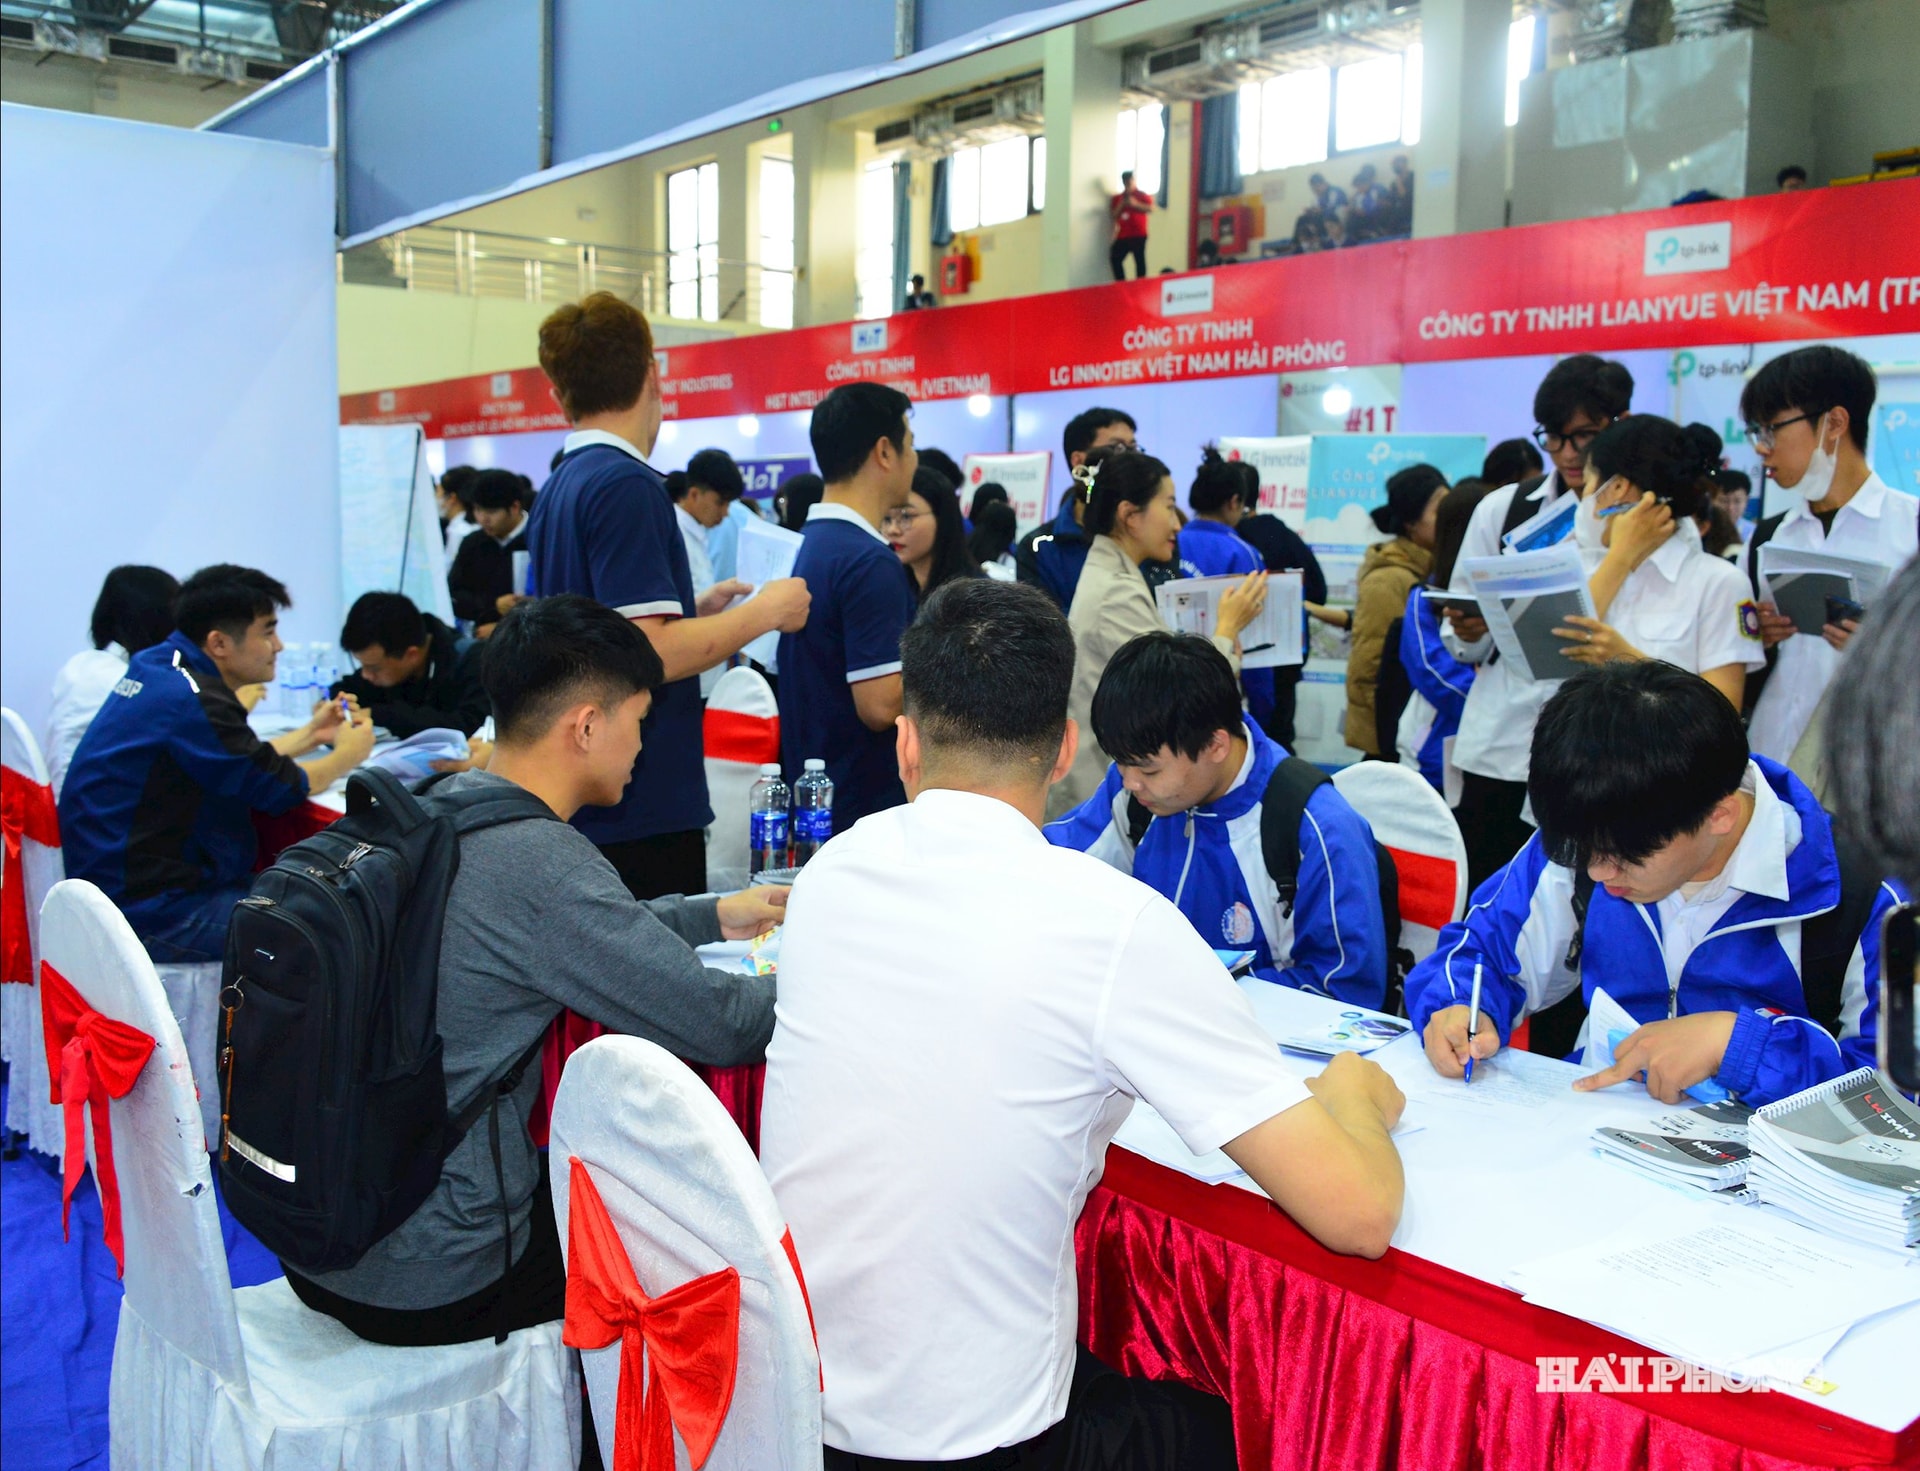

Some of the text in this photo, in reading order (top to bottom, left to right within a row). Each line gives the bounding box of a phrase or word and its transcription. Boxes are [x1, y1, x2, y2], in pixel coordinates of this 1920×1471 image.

[1681, 242, 1720, 259] tp-link
[1419, 309, 1485, 340] CÔNG
[1490, 309, 1520, 335] TY
[1524, 302, 1595, 332] TNHH
[1601, 291, 1717, 327] LIANYUE
[1724, 281, 1790, 321] VIỆT
[1797, 280, 1870, 312] NAM
[1122, 318, 1253, 351] CÔNG TY TNHH
[826, 355, 915, 382] CÔNG TY TNHH
[1050, 338, 1346, 387] LG INNOTEK VIỆT NAM HẢI PHÒNG
[1699, 359, 1749, 379] tp-link
[921, 372, 992, 399] (VIETNAM)
